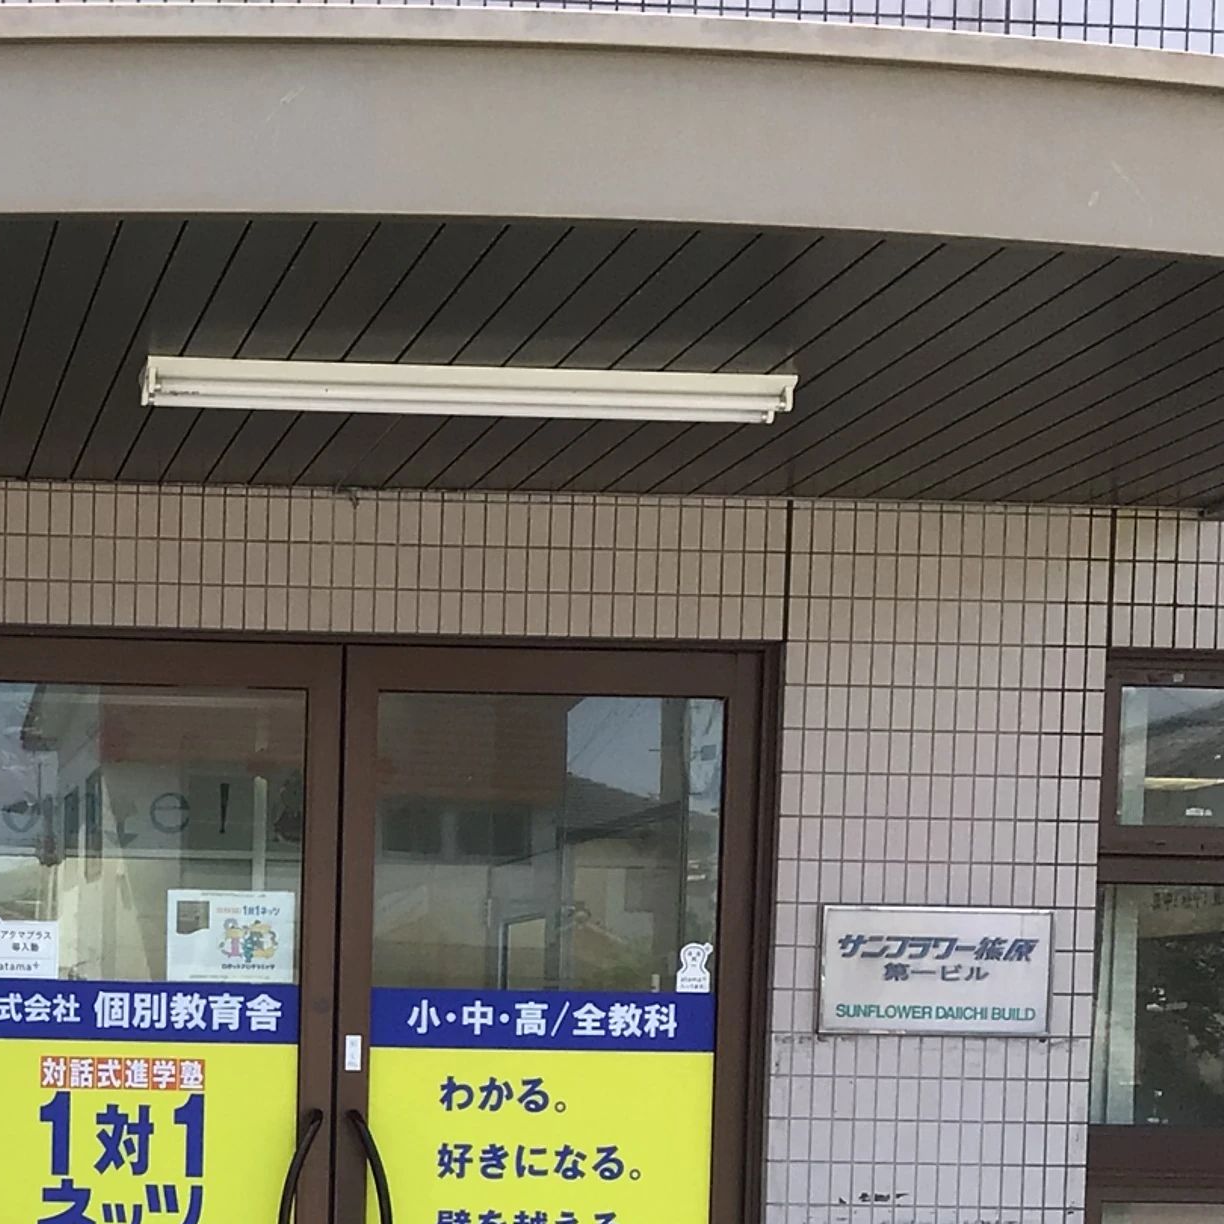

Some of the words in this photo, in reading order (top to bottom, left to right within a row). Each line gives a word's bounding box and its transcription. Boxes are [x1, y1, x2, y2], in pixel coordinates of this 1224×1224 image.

[883, 962, 990, 982] 第一ビル
[94, 990, 282, 1031] 個別教育舎
[836, 1004, 932, 1020] SUNFLOWER
[935, 1006, 988, 1021] DAIICHI
[992, 1007, 1036, 1021] BUILD
[41, 1057, 204, 1090] 対話式進学塾
[439, 1076, 566, 1113] わかる。
[39, 1091, 205, 1177] 1対1
[437, 1143, 641, 1180] 好きになる。
